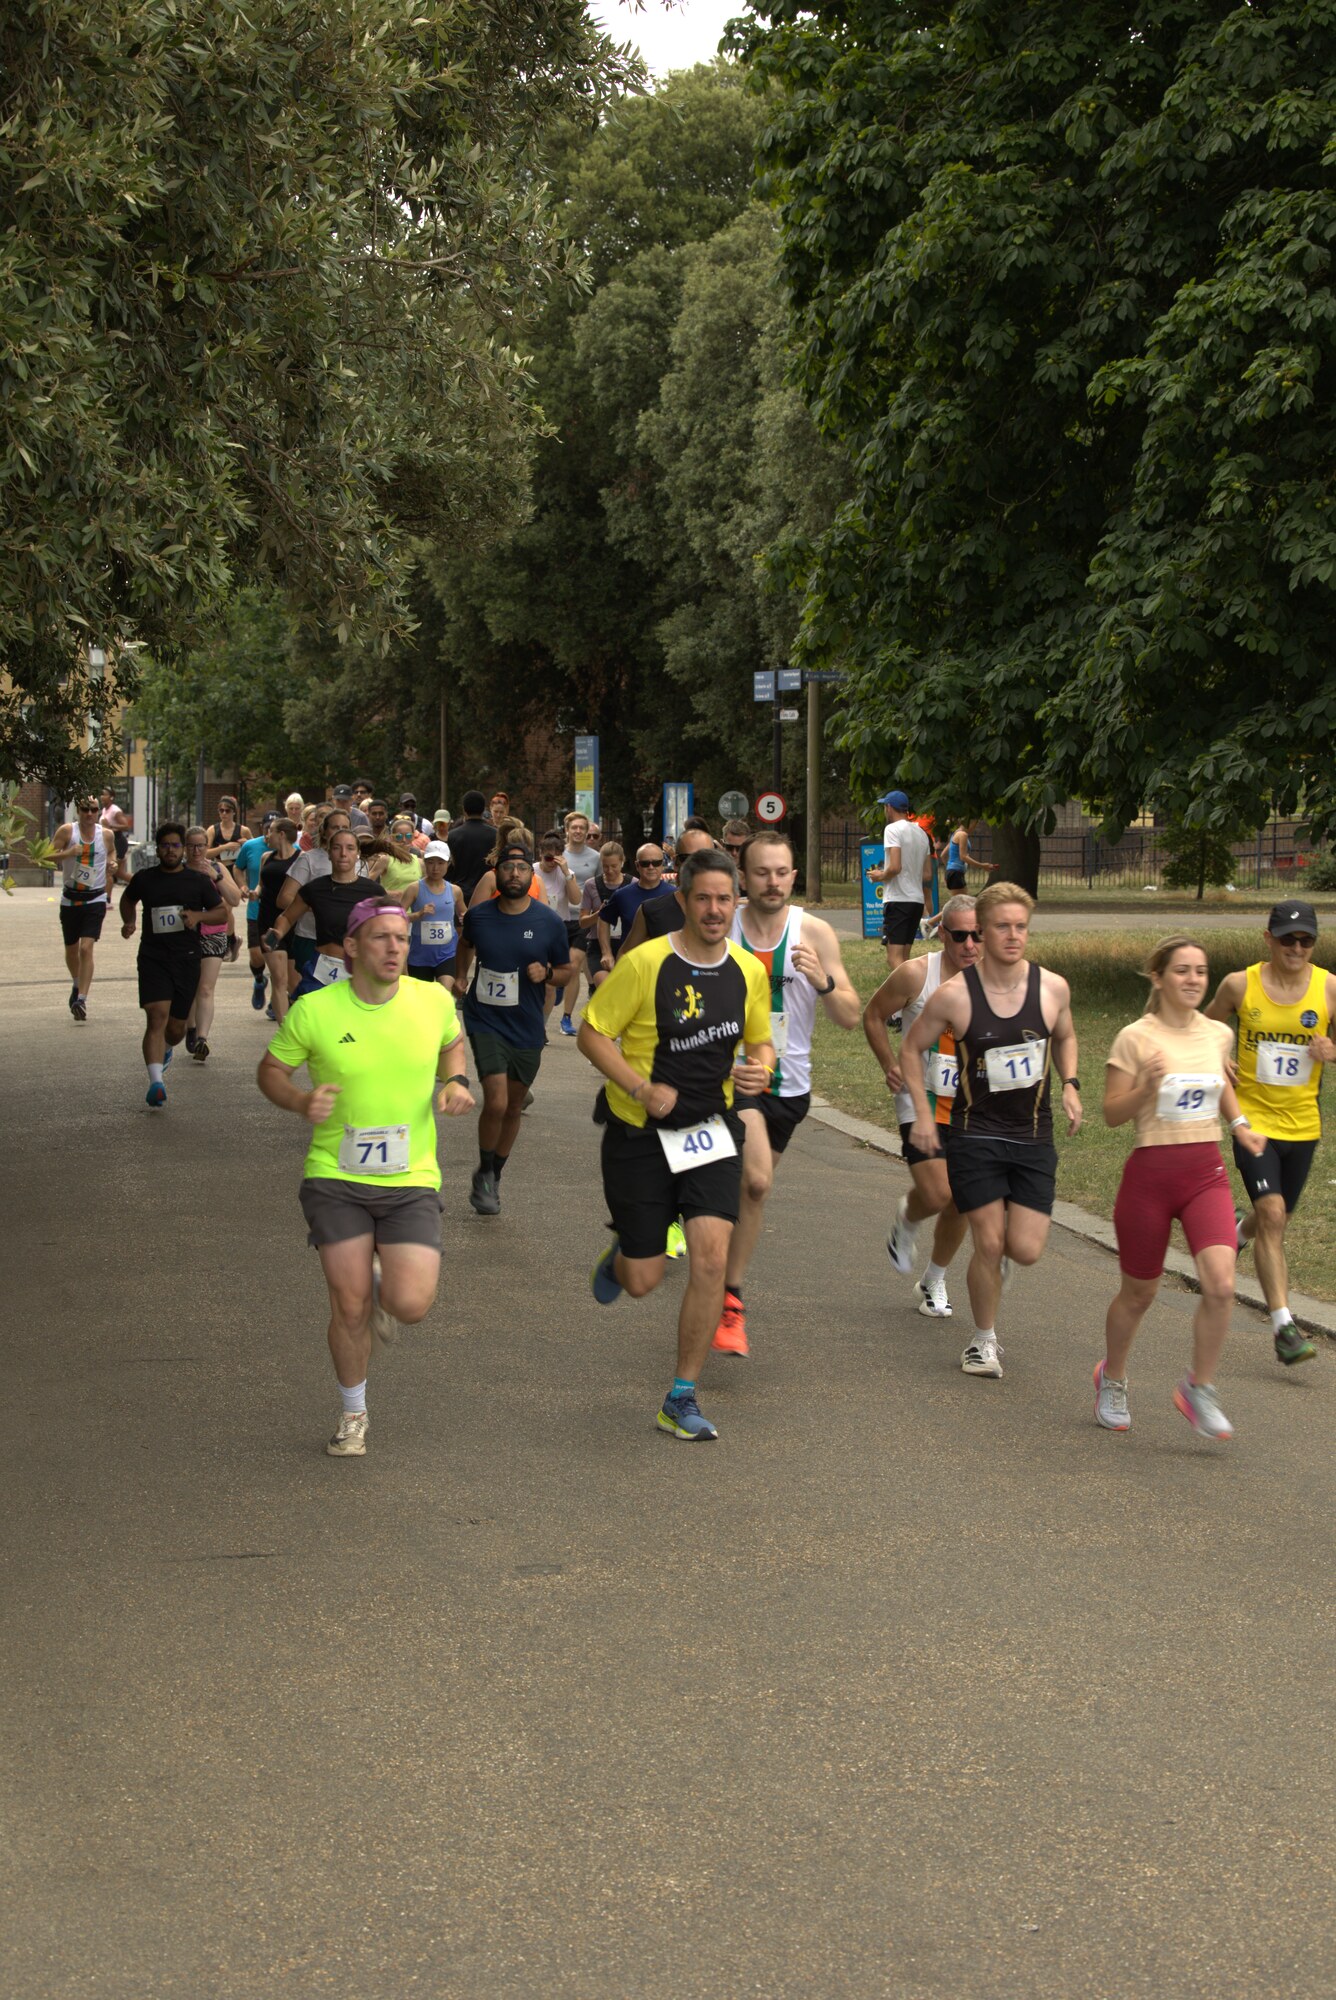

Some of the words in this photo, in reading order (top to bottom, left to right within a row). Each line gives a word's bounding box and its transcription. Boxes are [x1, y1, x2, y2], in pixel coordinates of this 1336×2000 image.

[766, 801, 775, 814] 5
[77, 869, 90, 881] 79
[159, 914, 176, 927] 10
[429, 928, 445, 940] 38
[328, 967, 339, 981] 4
[487, 981, 507, 998] 12
[669, 1020, 740, 1052] Run&Frite
[1004, 1056, 1031, 1079] 11
[1273, 1056, 1300, 1076] 18
[1175, 1089, 1205, 1110] 49
[683, 1129, 714, 1154] 40
[356, 1141, 388, 1164] 71
